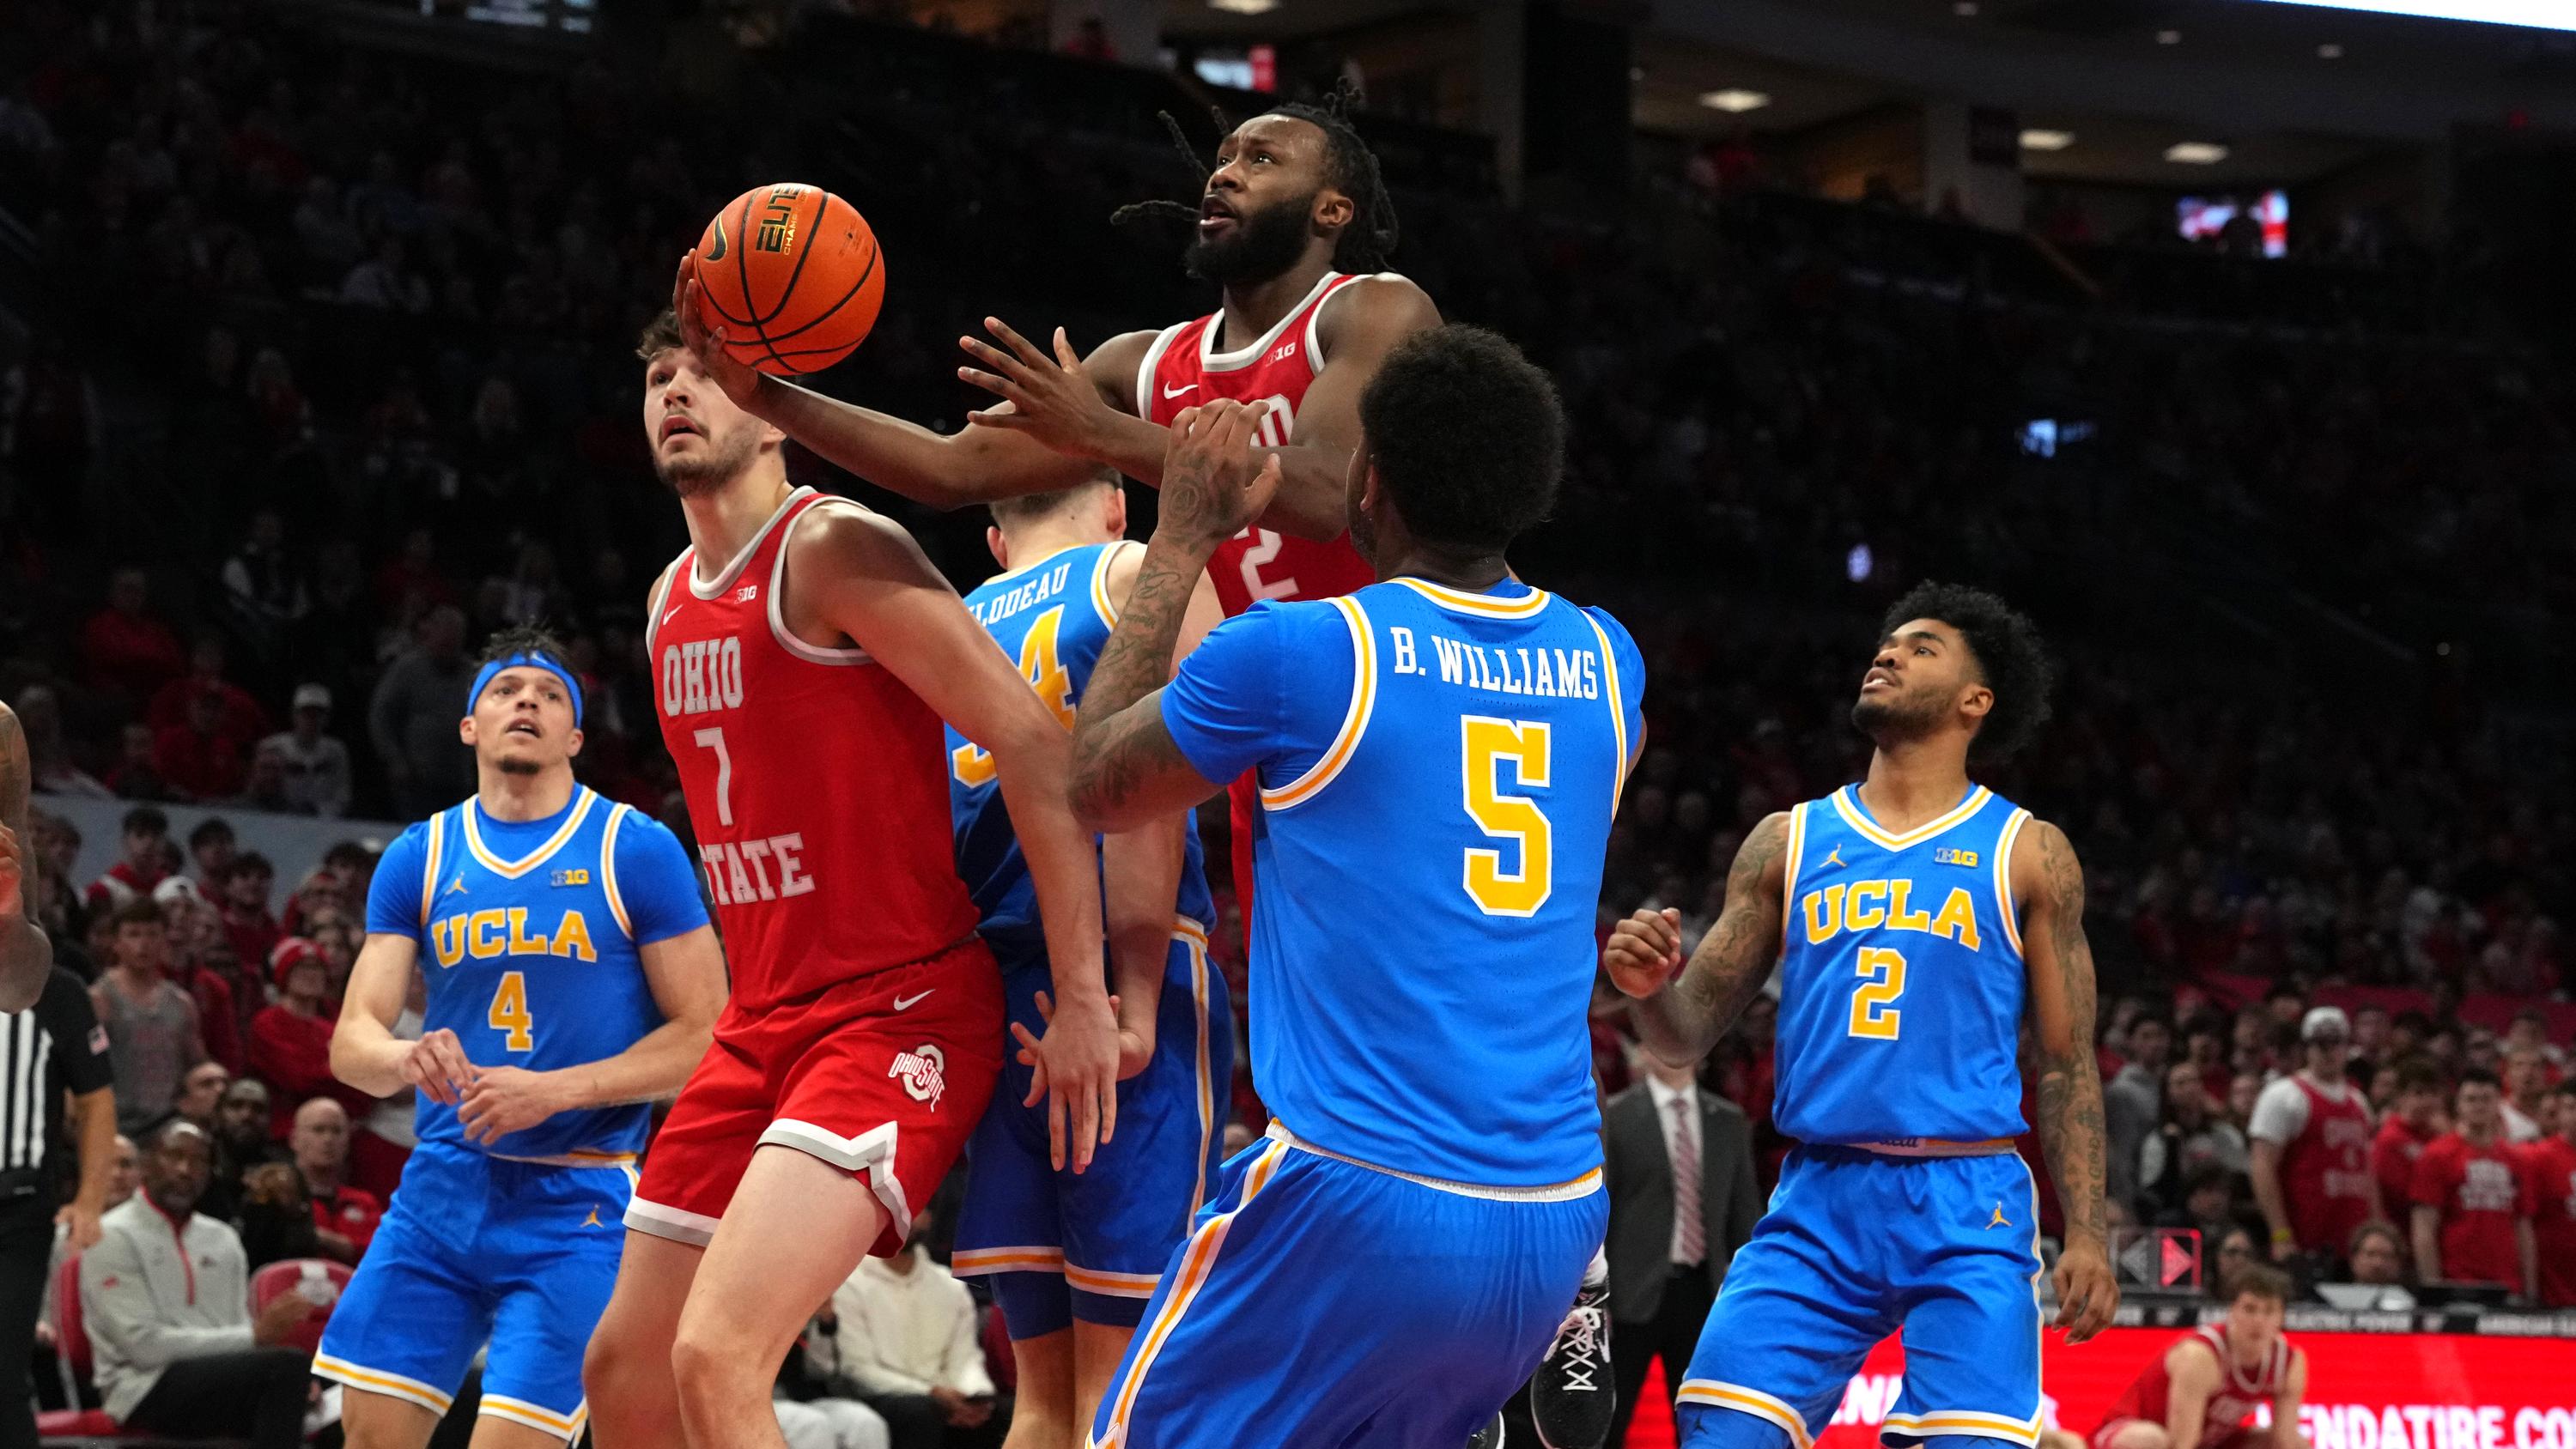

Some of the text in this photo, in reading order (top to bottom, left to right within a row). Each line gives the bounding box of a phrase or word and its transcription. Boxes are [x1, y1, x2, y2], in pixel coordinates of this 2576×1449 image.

[968, 562, 1072, 627] LODEAU
[663, 636, 744, 717] OHIO
[1389, 627, 1598, 700] B. WILLIAMS
[694, 726, 733, 826] 7
[1461, 714, 1552, 918] 5
[431, 906, 598, 969] UCLA
[1802, 879, 1981, 953] UCLA
[488, 971, 533, 1052] 4
[1848, 946, 1907, 1040] 2
